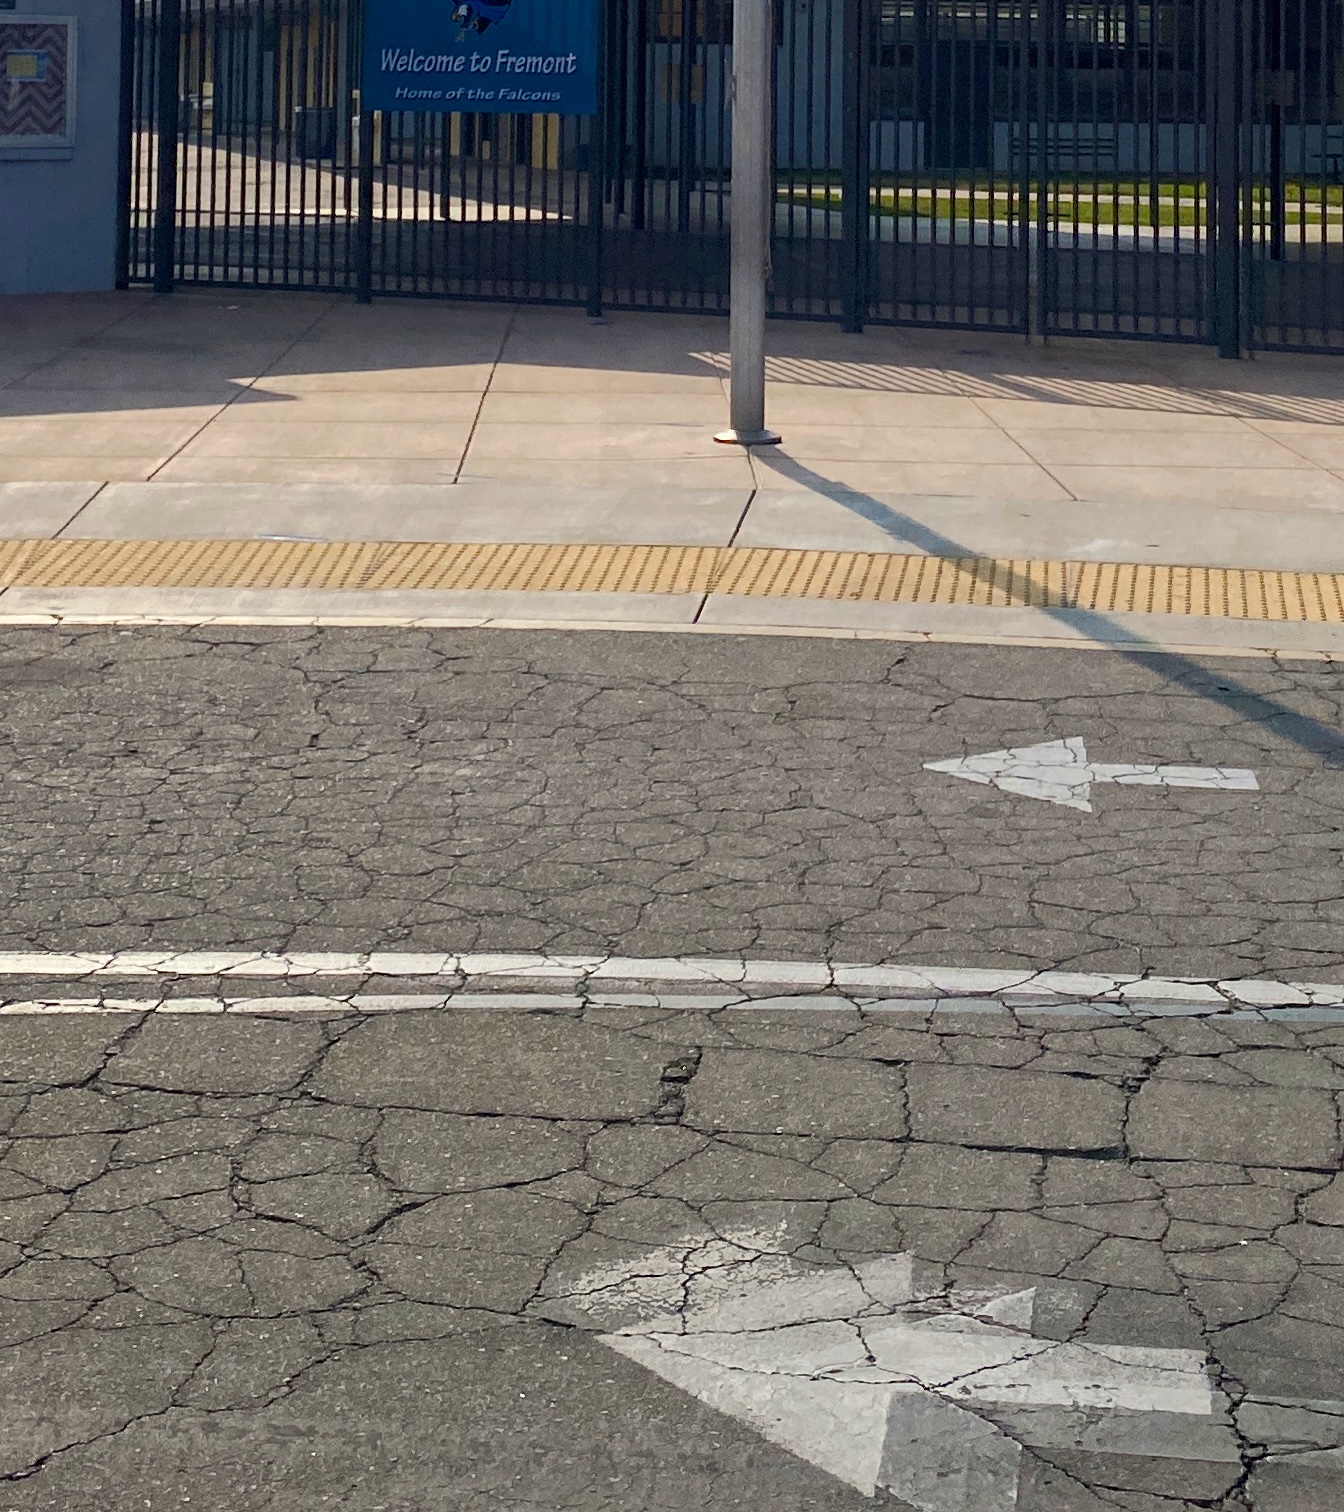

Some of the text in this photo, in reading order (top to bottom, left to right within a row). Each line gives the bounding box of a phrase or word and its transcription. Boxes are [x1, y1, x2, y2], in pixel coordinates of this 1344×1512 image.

[381, 48, 578, 75] Welcome to Fremont
[394, 87, 562, 103] Home of the Falcons
